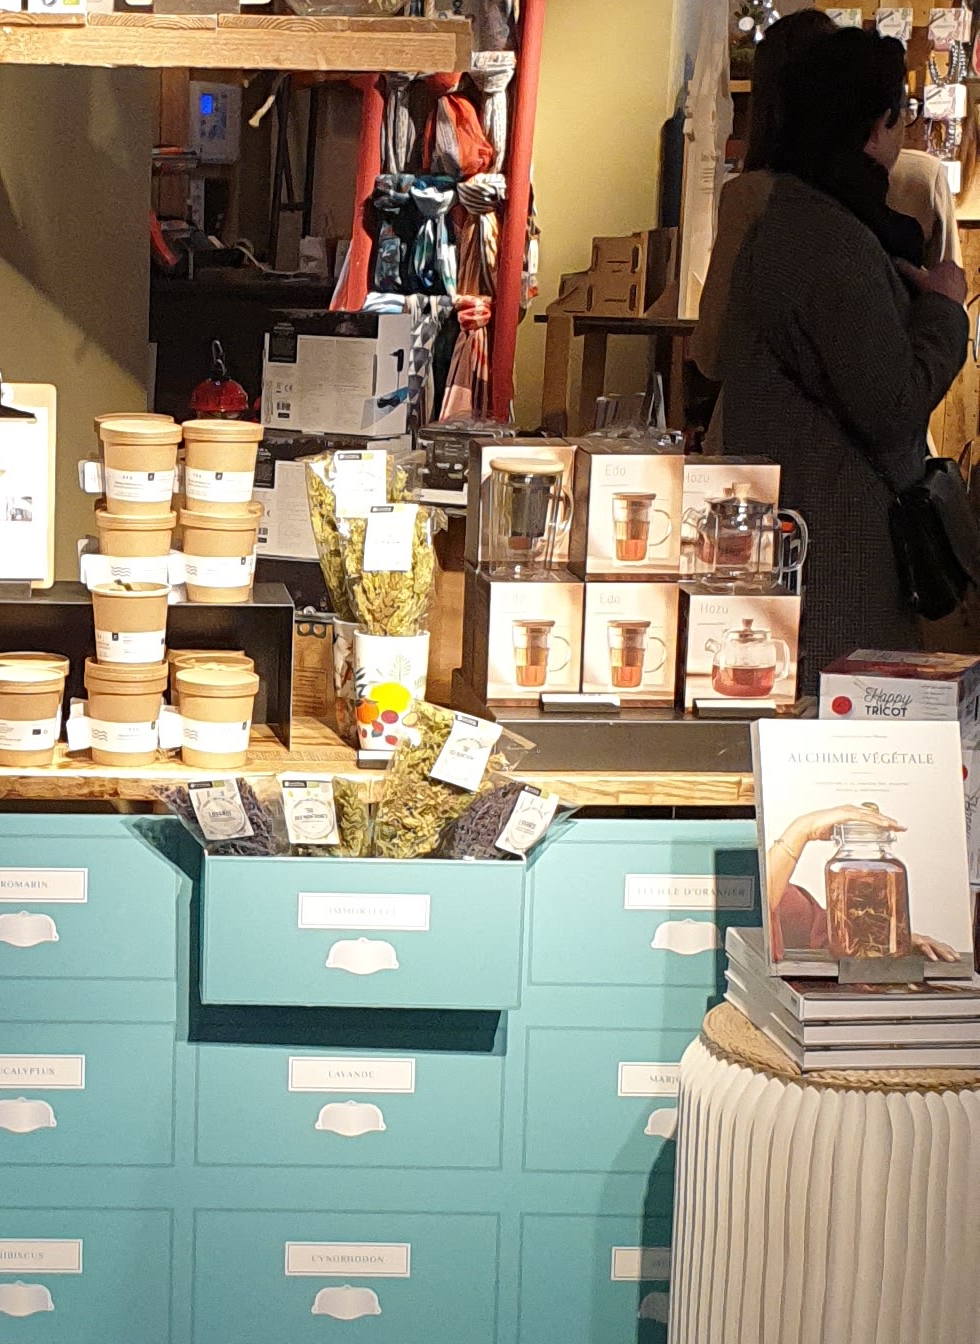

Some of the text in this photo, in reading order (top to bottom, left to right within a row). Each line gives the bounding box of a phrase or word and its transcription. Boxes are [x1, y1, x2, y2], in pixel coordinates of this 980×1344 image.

[605, 463, 626, 477] Edo
[864, 687, 913, 706] Happy
[865, 705, 908, 718] TRICOT
[788, 750, 934, 765] ALCHIMIE VÉGÉTALE
[0, 880, 48, 889] ROMARIN
[328, 1070, 375, 1079] LAVANDE
